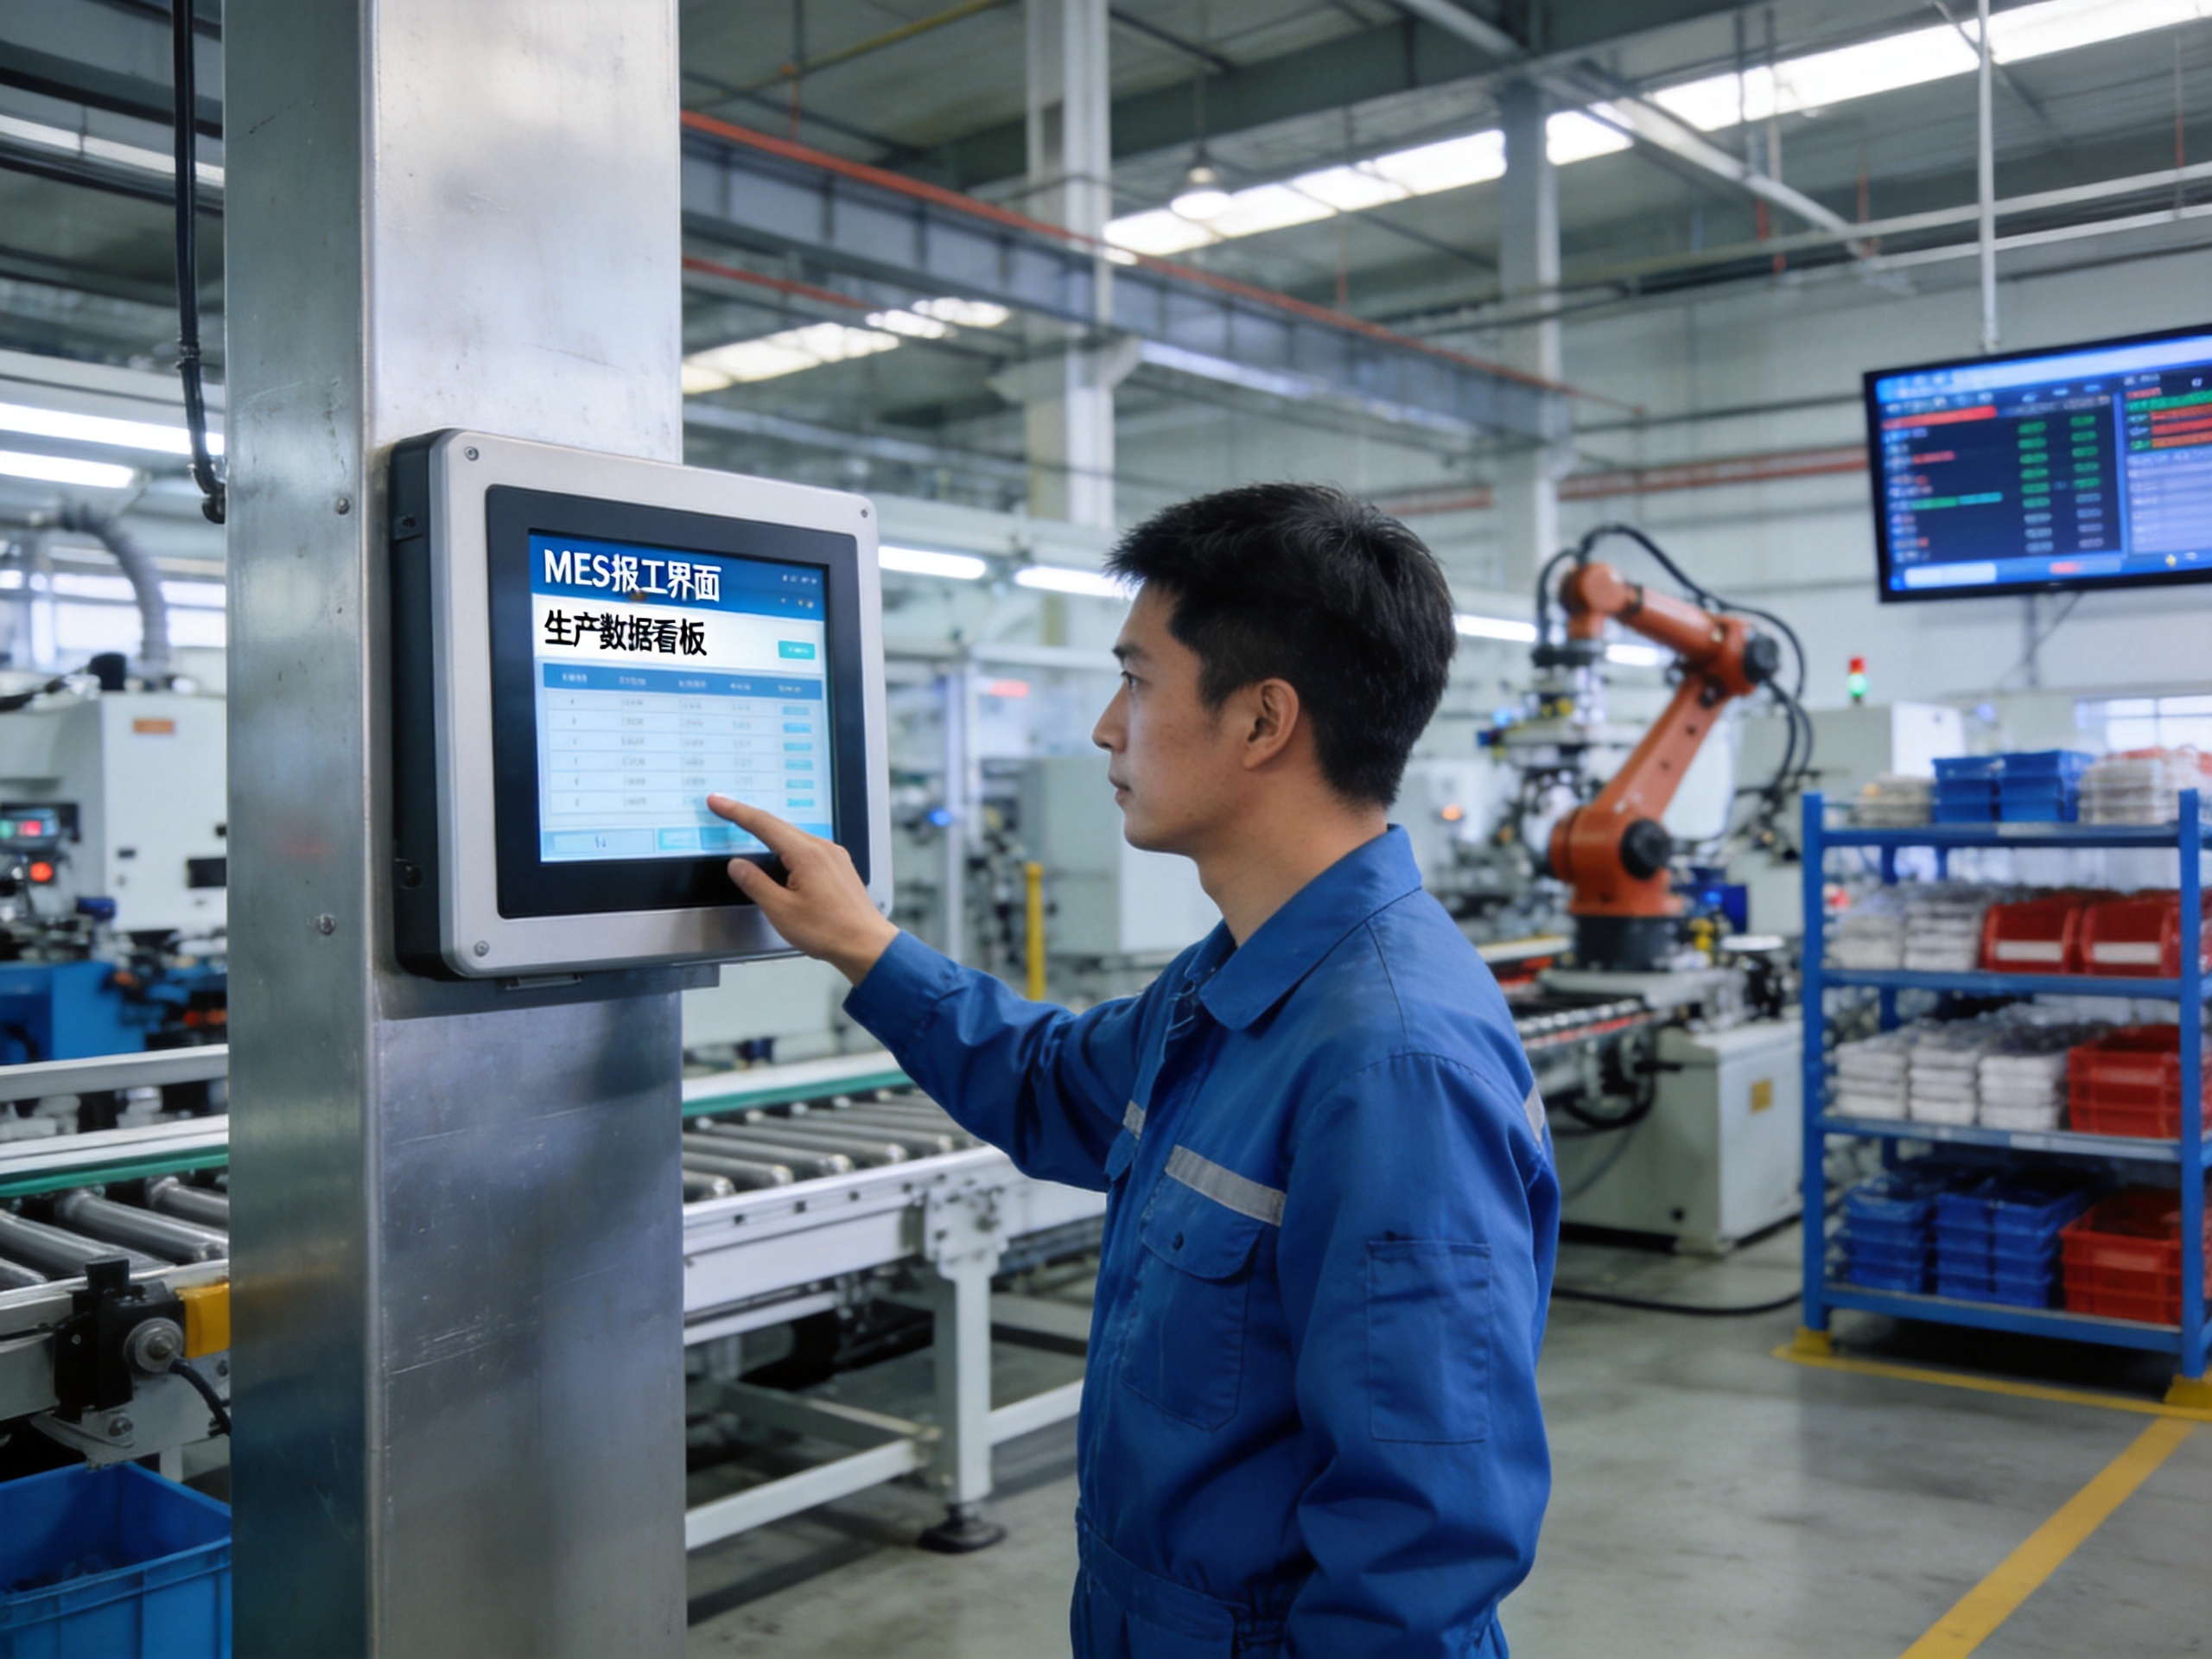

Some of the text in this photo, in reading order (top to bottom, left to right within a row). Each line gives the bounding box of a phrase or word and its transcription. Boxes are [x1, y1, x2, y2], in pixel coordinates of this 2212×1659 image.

[544, 550, 721, 602] MES报工界面
[544, 609, 707, 656] 生产数据看板
